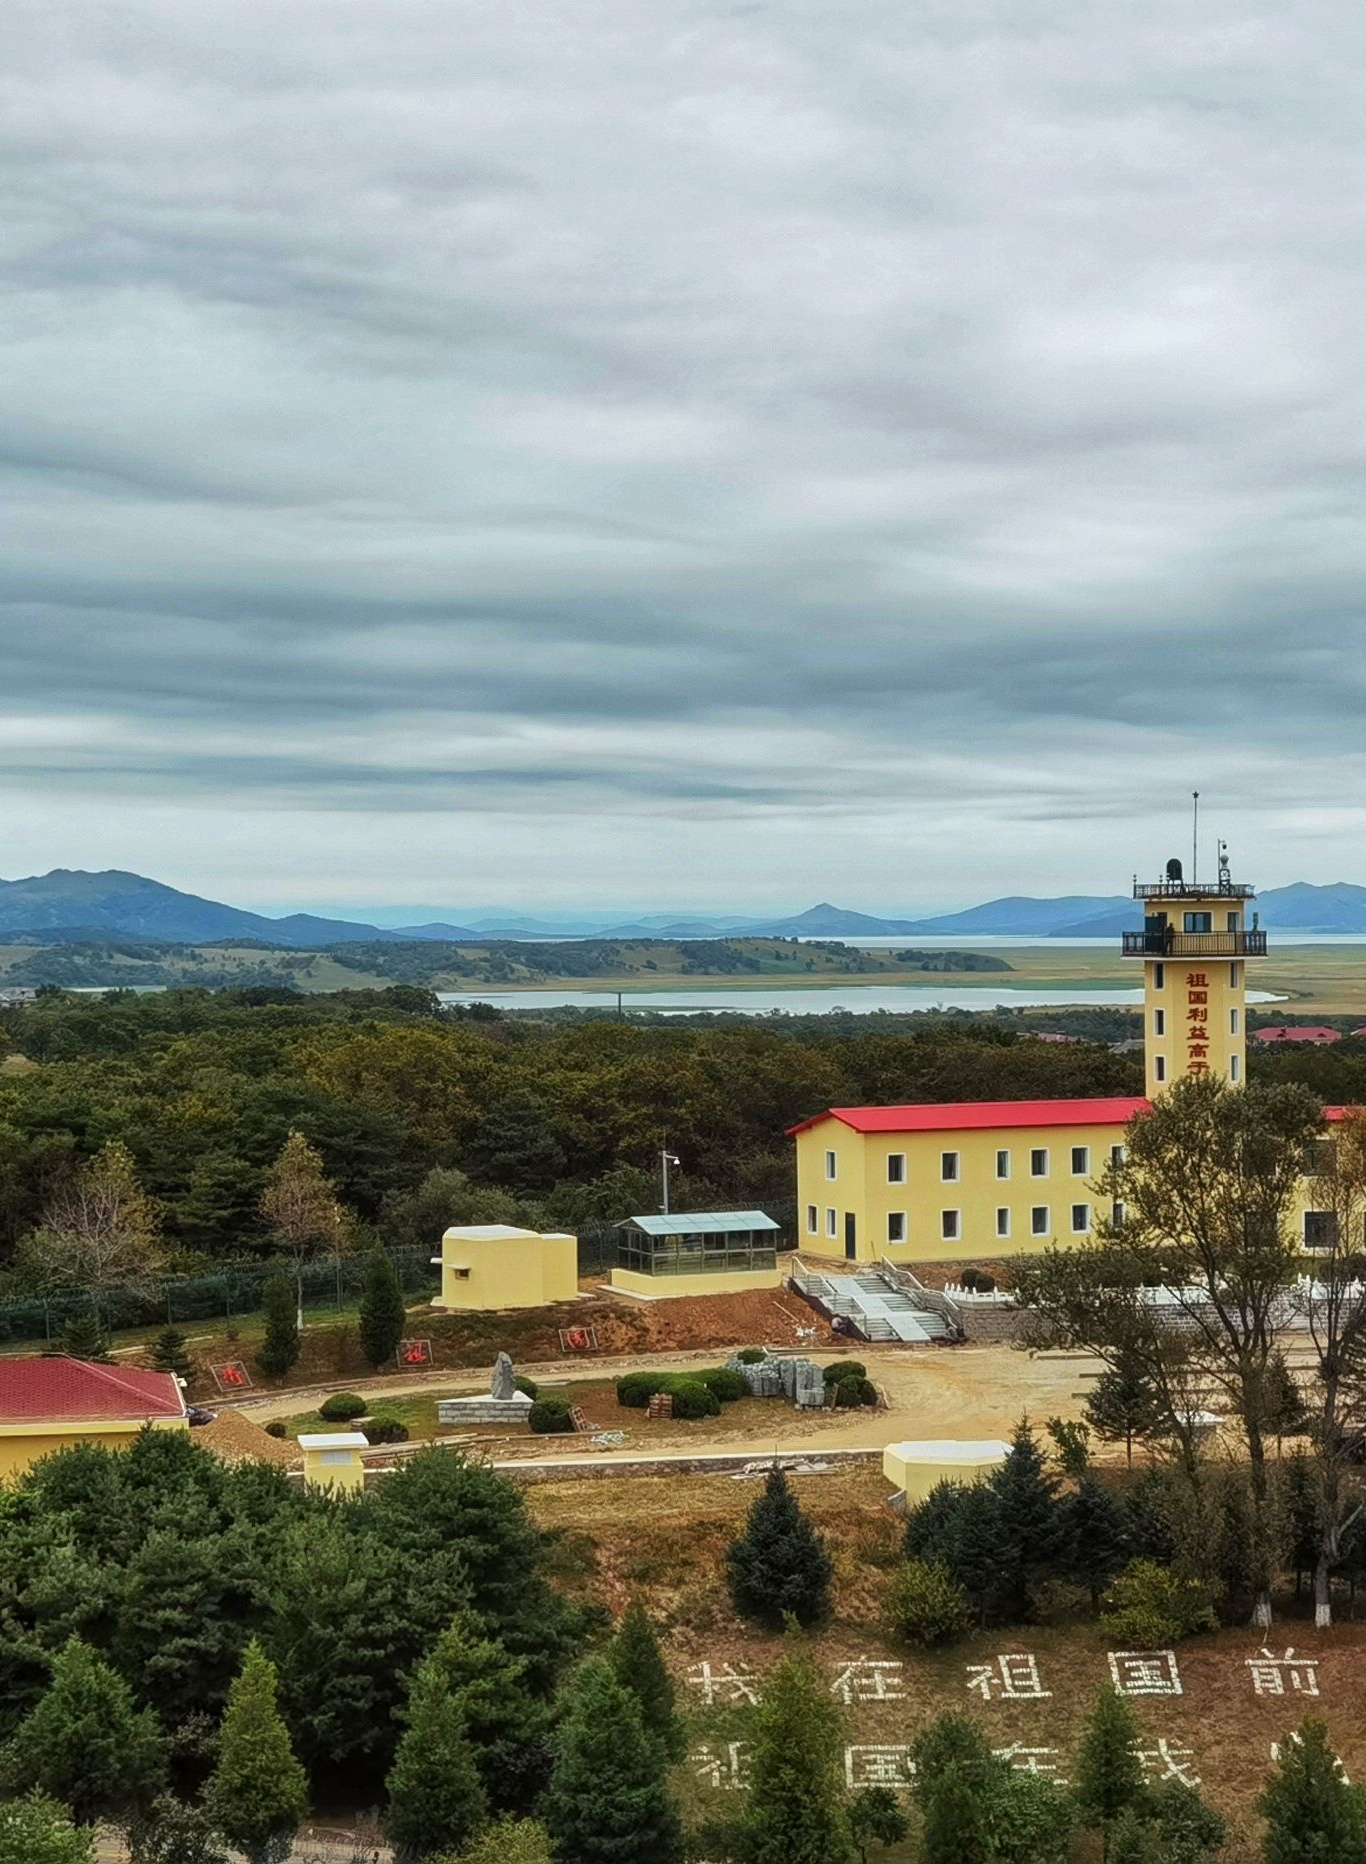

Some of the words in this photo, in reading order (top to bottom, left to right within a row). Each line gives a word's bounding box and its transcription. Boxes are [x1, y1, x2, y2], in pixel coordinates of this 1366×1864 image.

[1186, 973, 1210, 1076] 祖国利益高于
